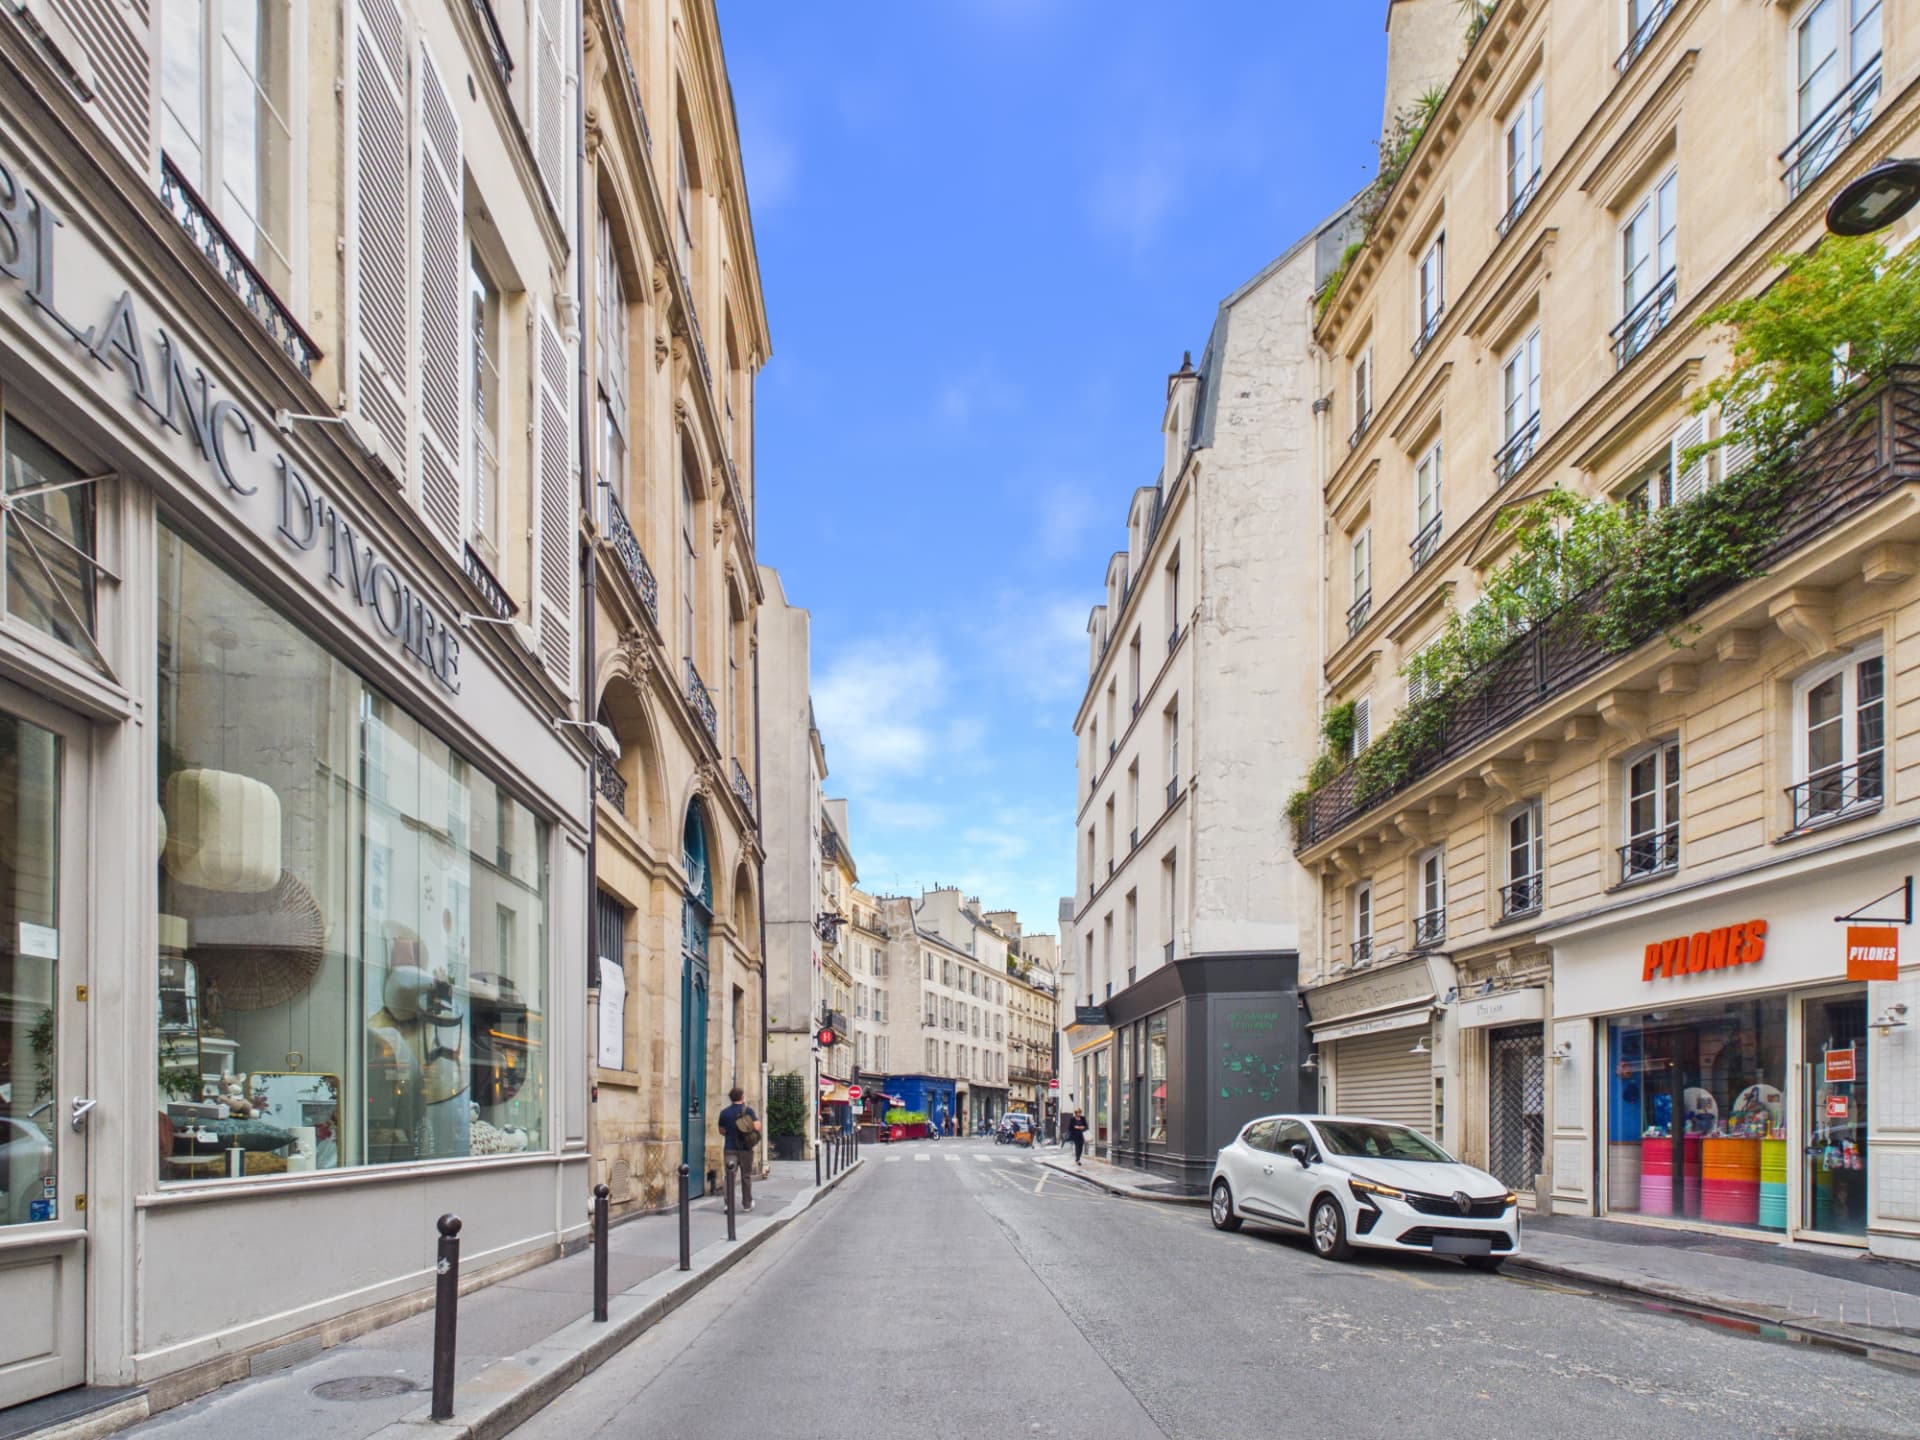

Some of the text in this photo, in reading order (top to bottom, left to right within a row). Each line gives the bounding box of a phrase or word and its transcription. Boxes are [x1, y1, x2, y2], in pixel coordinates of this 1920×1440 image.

[277, 453, 460, 695] D'IVOIRE
[1642, 919, 1767, 982] PYLONES
[1850, 946, 1896, 961] PYLONES
